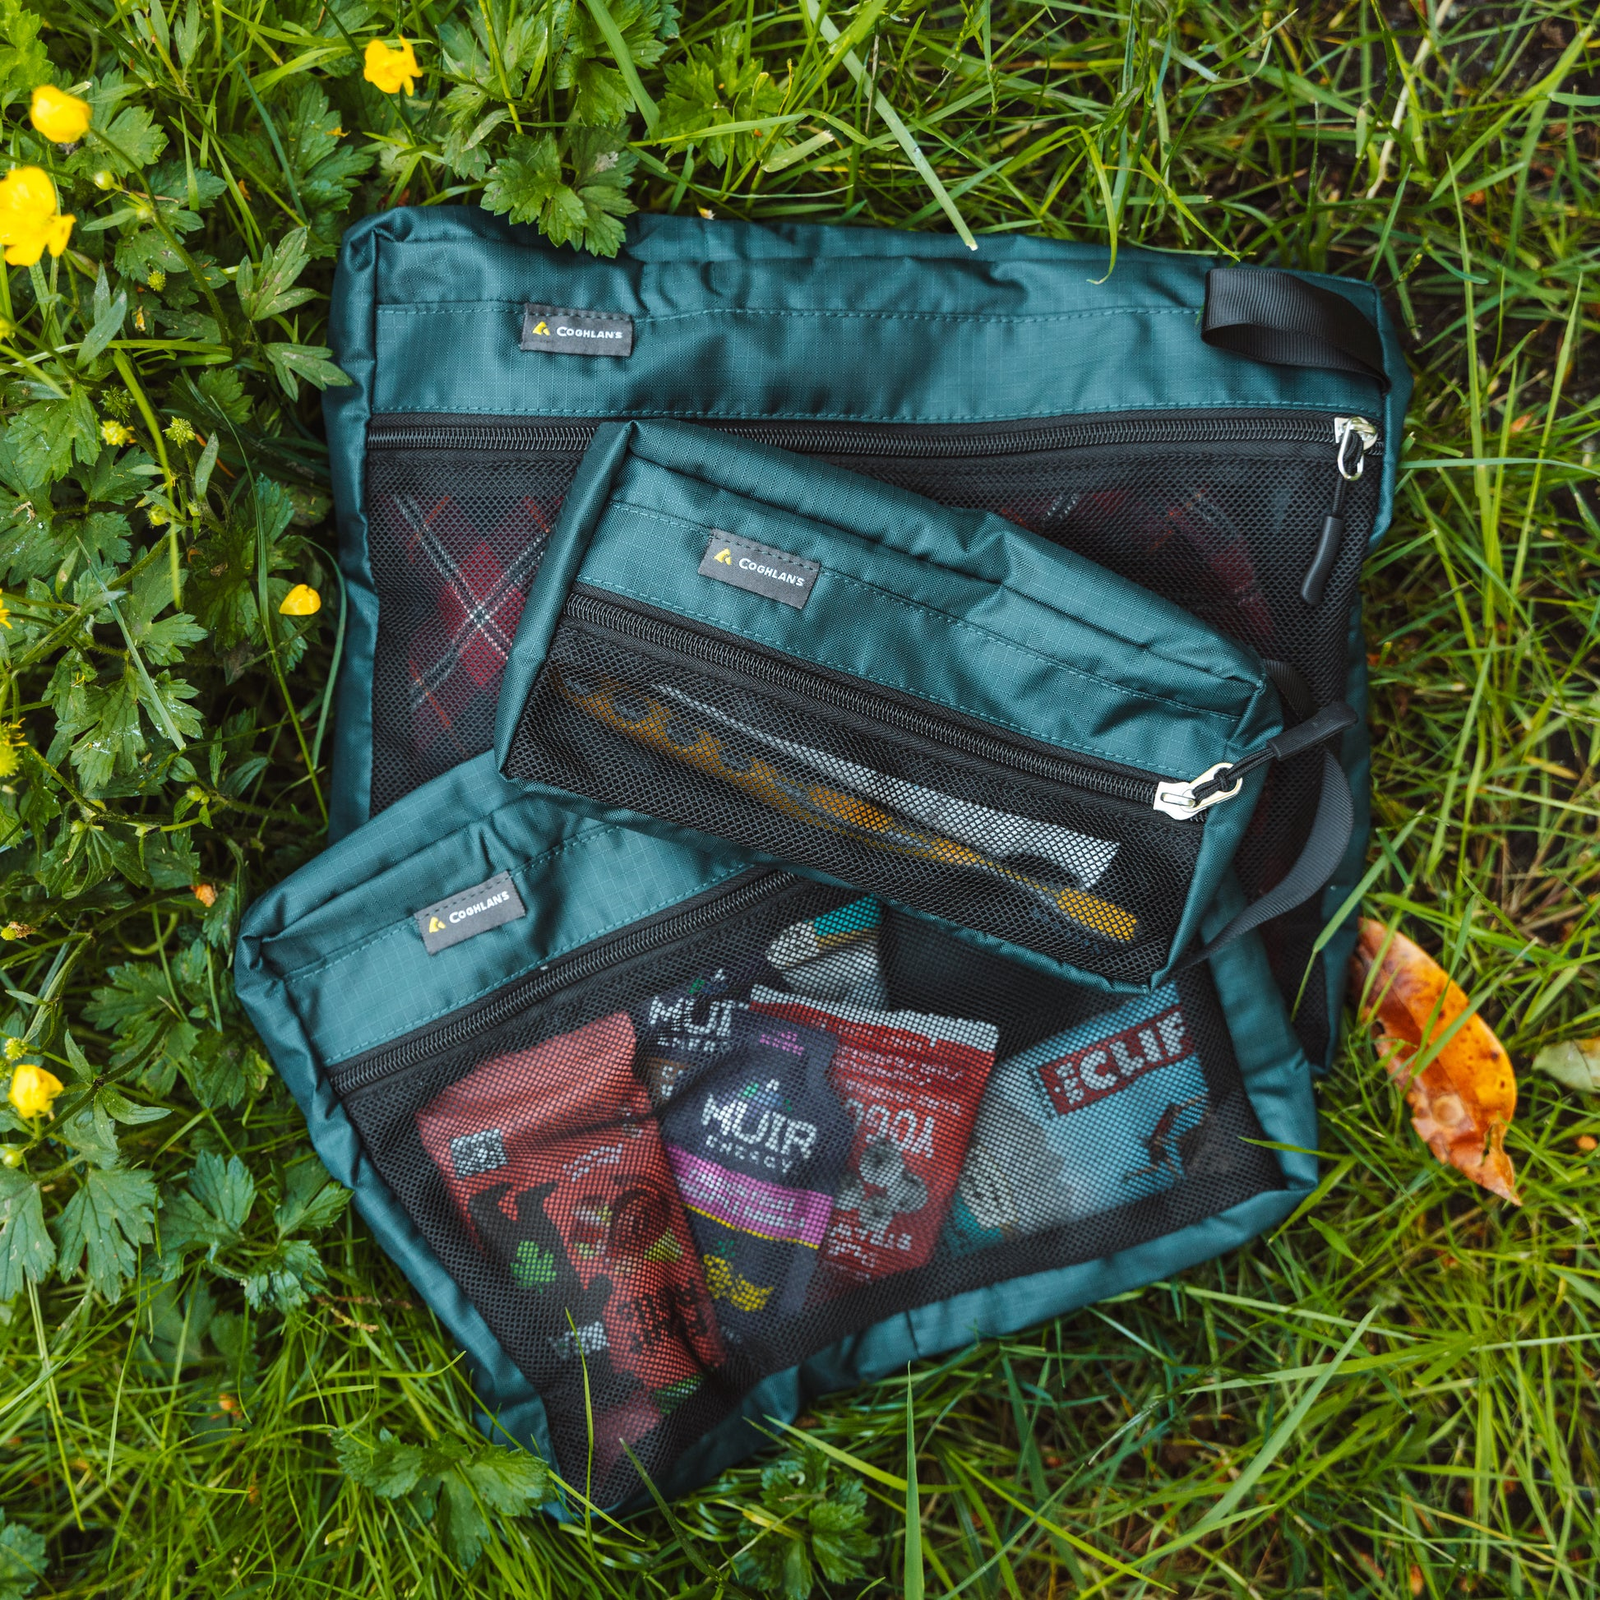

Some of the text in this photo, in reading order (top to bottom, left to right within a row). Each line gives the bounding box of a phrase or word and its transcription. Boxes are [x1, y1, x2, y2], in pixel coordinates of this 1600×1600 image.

[648, 997, 748, 1037] MUI
[1079, 1011, 1187, 1092] CLIF
[701, 1094, 818, 1160] MUIR
[705, 1134, 794, 1174] ENERGY
